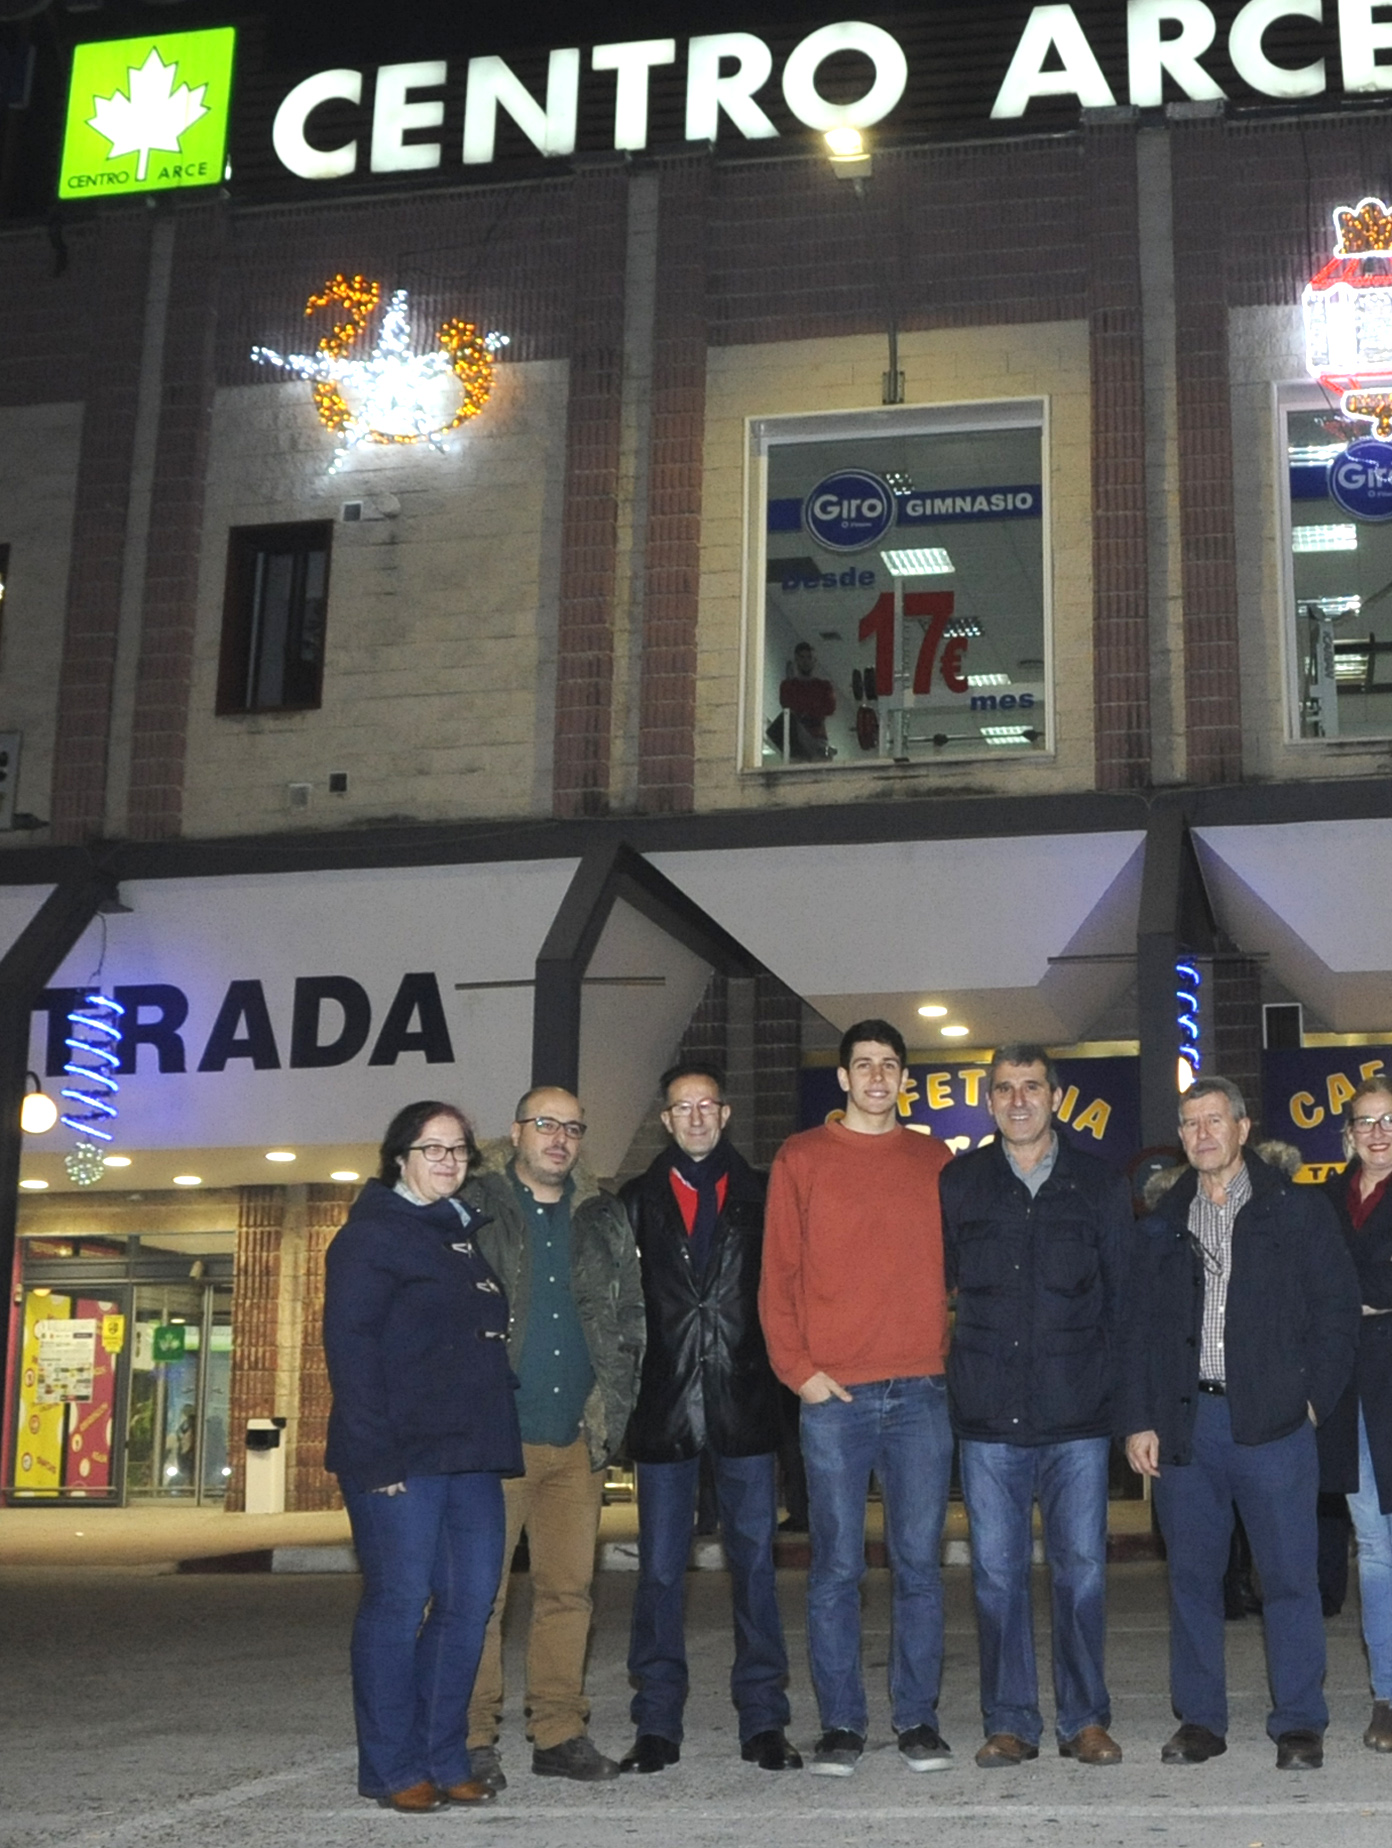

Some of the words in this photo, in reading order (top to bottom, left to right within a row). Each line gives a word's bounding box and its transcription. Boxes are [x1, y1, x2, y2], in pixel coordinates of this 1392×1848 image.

[273, 20, 908, 180] CENTRO
[67, 171, 129, 189] CENTRO
[158, 162, 208, 180] ARCE
[813, 494, 884, 520] Giro
[905, 492, 1034, 517] GIMNASIO
[970, 692, 1035, 711] mes
[825, 1068, 1112, 1140] FETIA
